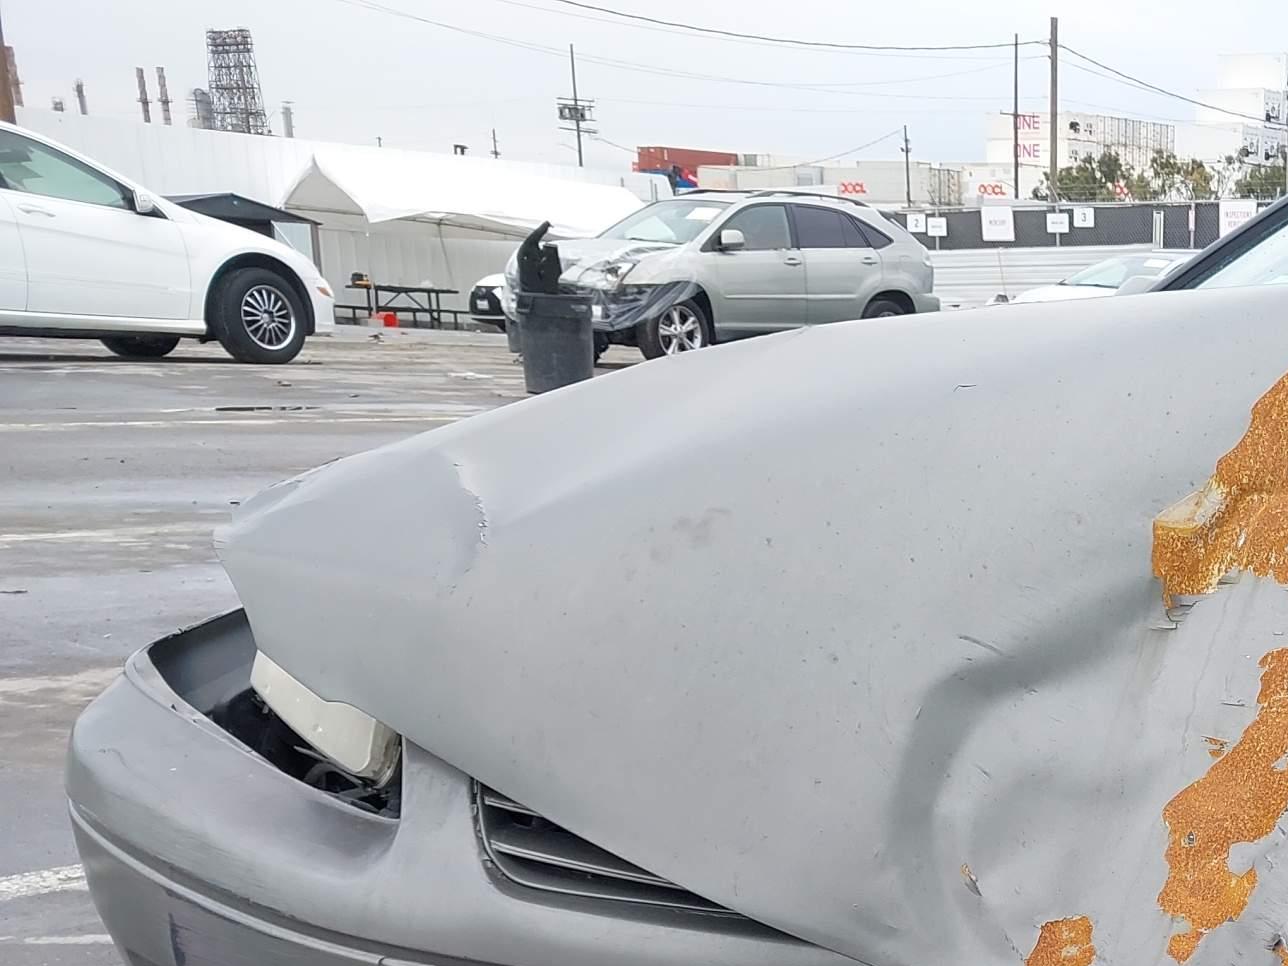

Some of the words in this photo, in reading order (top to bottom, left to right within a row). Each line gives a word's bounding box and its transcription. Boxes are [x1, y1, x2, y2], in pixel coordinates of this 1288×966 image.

[978, 183, 1007, 196] OOCL
[913, 218, 920, 228] 2
[1081, 212, 1088, 223] 3
